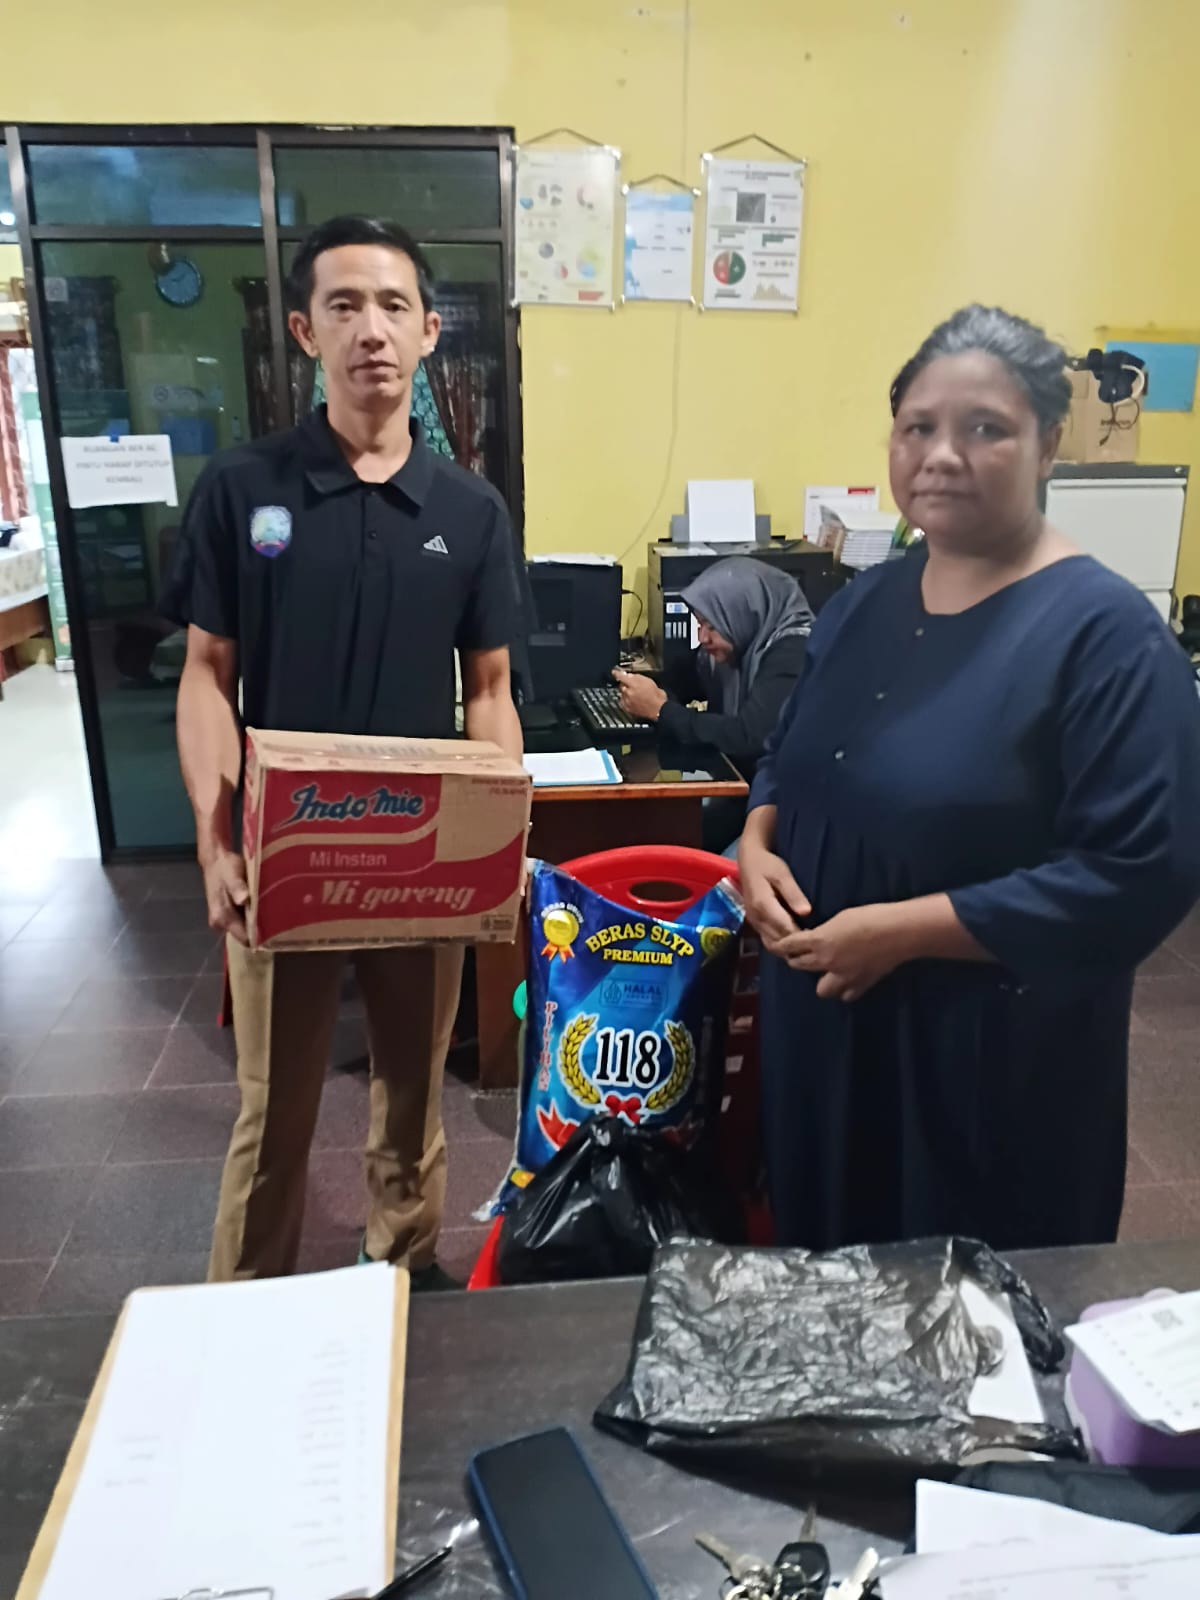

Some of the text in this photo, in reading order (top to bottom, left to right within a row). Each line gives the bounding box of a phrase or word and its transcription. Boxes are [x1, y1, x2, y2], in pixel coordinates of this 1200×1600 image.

[310, 851, 388, 867] Mi Instan
[360, 887, 476, 911] goreng
[584, 922, 695, 957] BERAS SLYP
[603, 948, 673, 966] PREMIUM
[624, 983, 662, 995] HALAL
[594, 1029, 660, 1087] 118
